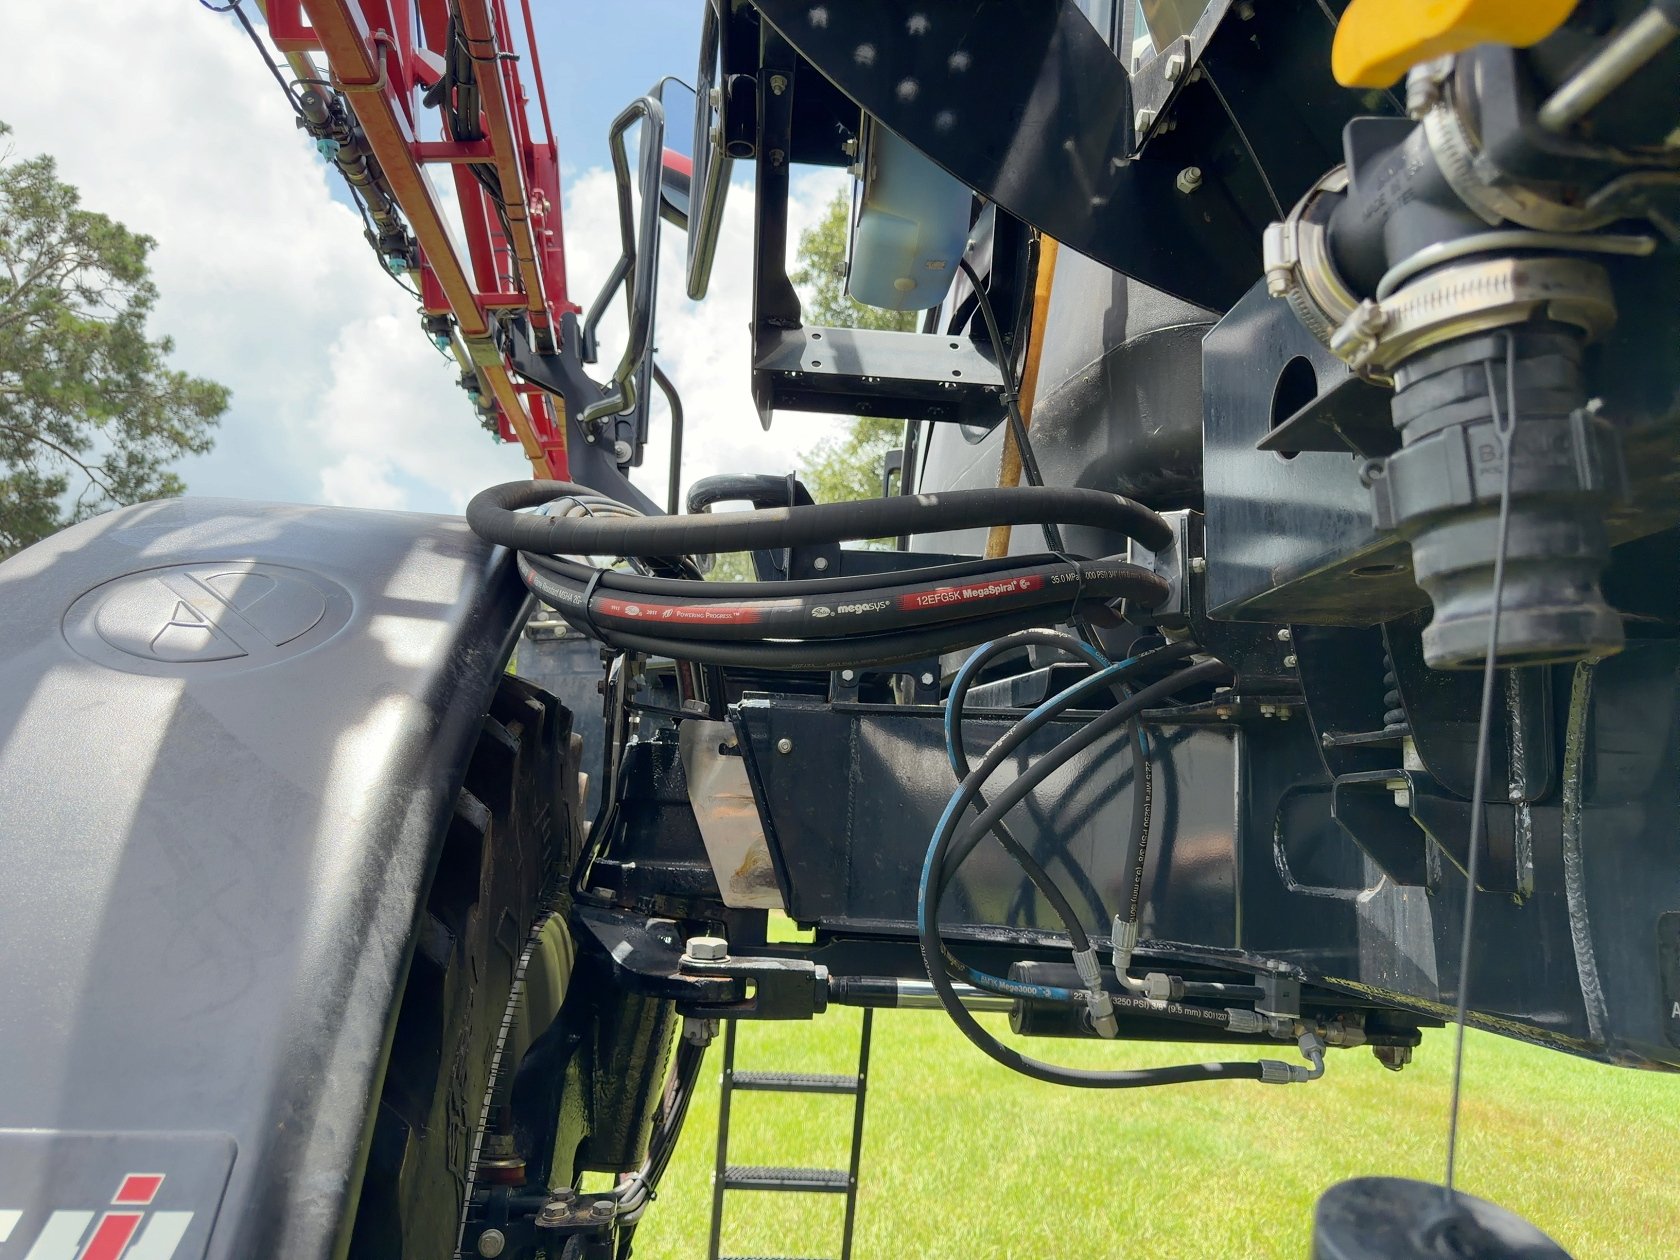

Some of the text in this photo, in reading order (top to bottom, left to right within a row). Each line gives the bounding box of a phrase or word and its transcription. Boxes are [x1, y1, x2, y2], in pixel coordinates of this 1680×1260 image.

[1050, 573, 1066, 585] 35.0
[916, 591, 962, 606] 12EFG5K
[999, 981, 1037, 995] Mega3000
[1132, 998, 1150, 1010] PSI)
[1167, 1004, 1183, 1014] (9.5
[1184, 1008, 1202, 1018] mm)
